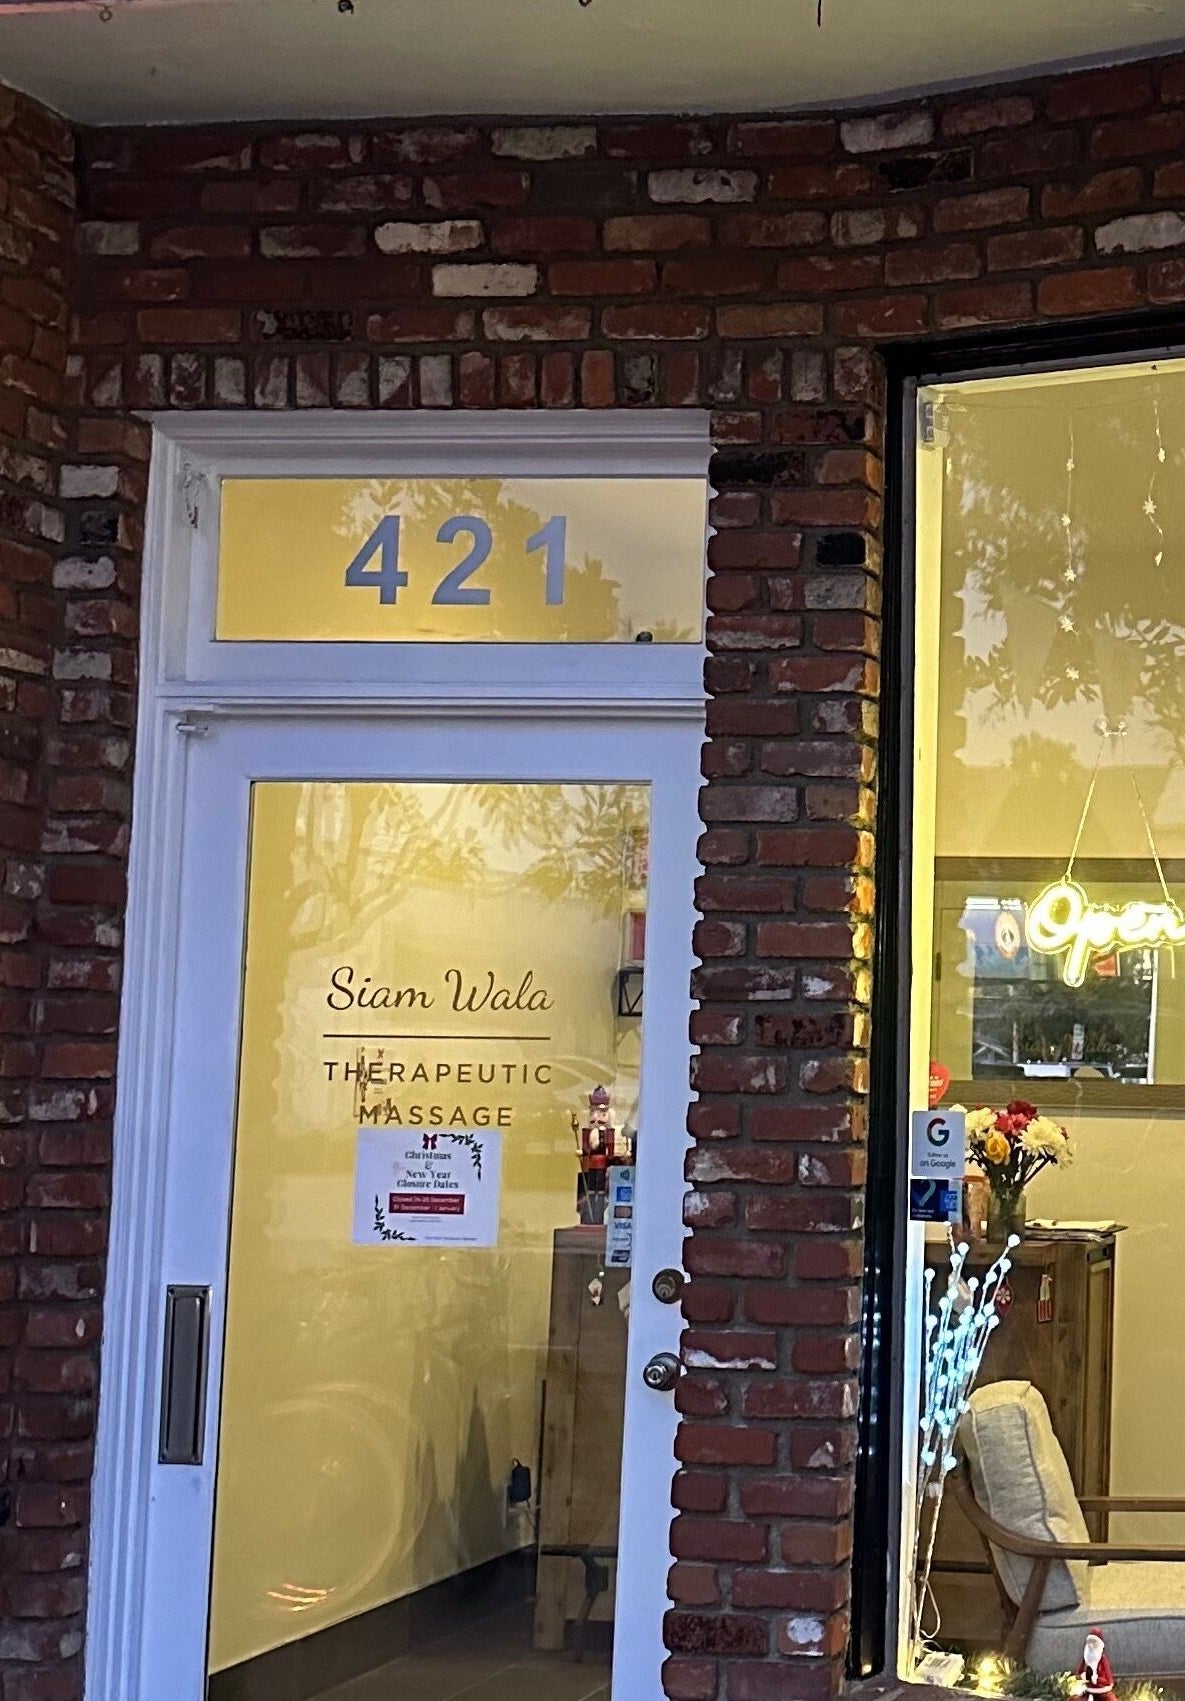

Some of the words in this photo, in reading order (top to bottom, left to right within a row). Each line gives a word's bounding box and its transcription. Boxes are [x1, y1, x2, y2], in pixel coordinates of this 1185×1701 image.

[345, 515, 567, 606] 421
[327, 966, 434, 1011] Siam
[445, 969, 554, 1012] Wala
[323, 1061, 552, 1084] THERAPEUTIC
[358, 1104, 513, 1127] MASSAGE
[405, 1150, 452, 1161] Christmas
[930, 1159, 956, 1170] Google
[406, 1170, 426, 1179] New
[430, 1170, 451, 1180] Year
[396, 1180, 431, 1189] Closure
[433, 1180, 459, 1189] Dates
